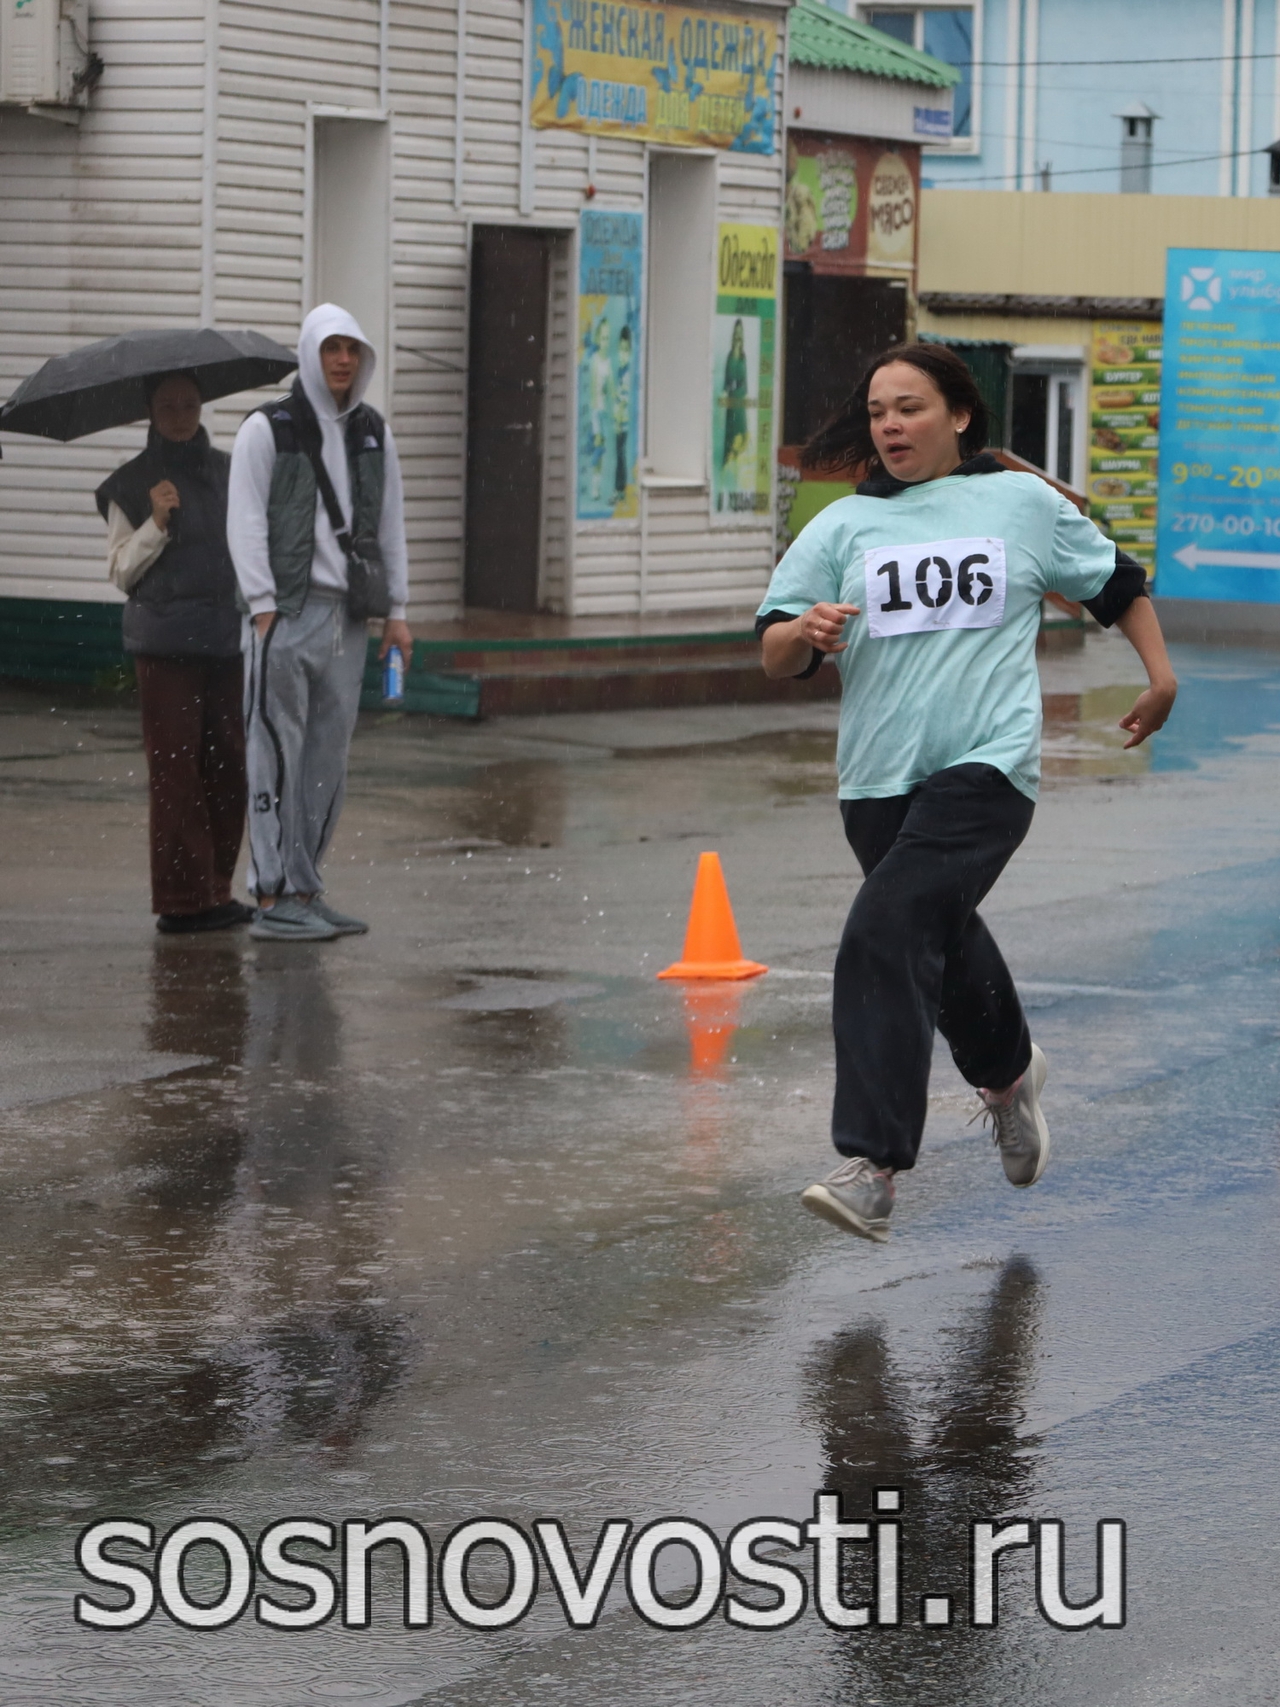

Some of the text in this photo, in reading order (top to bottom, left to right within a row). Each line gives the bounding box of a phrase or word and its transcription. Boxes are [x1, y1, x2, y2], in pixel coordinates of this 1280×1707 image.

[568, 0, 766, 84] ЖЕНСКАЯ ОДЕЖДА
[576, 76, 648, 128] ОДЕЖДА
[871, 197, 913, 236] МЯСО
[720, 233, 776, 290] Одежда
[877, 553, 993, 612] 106
